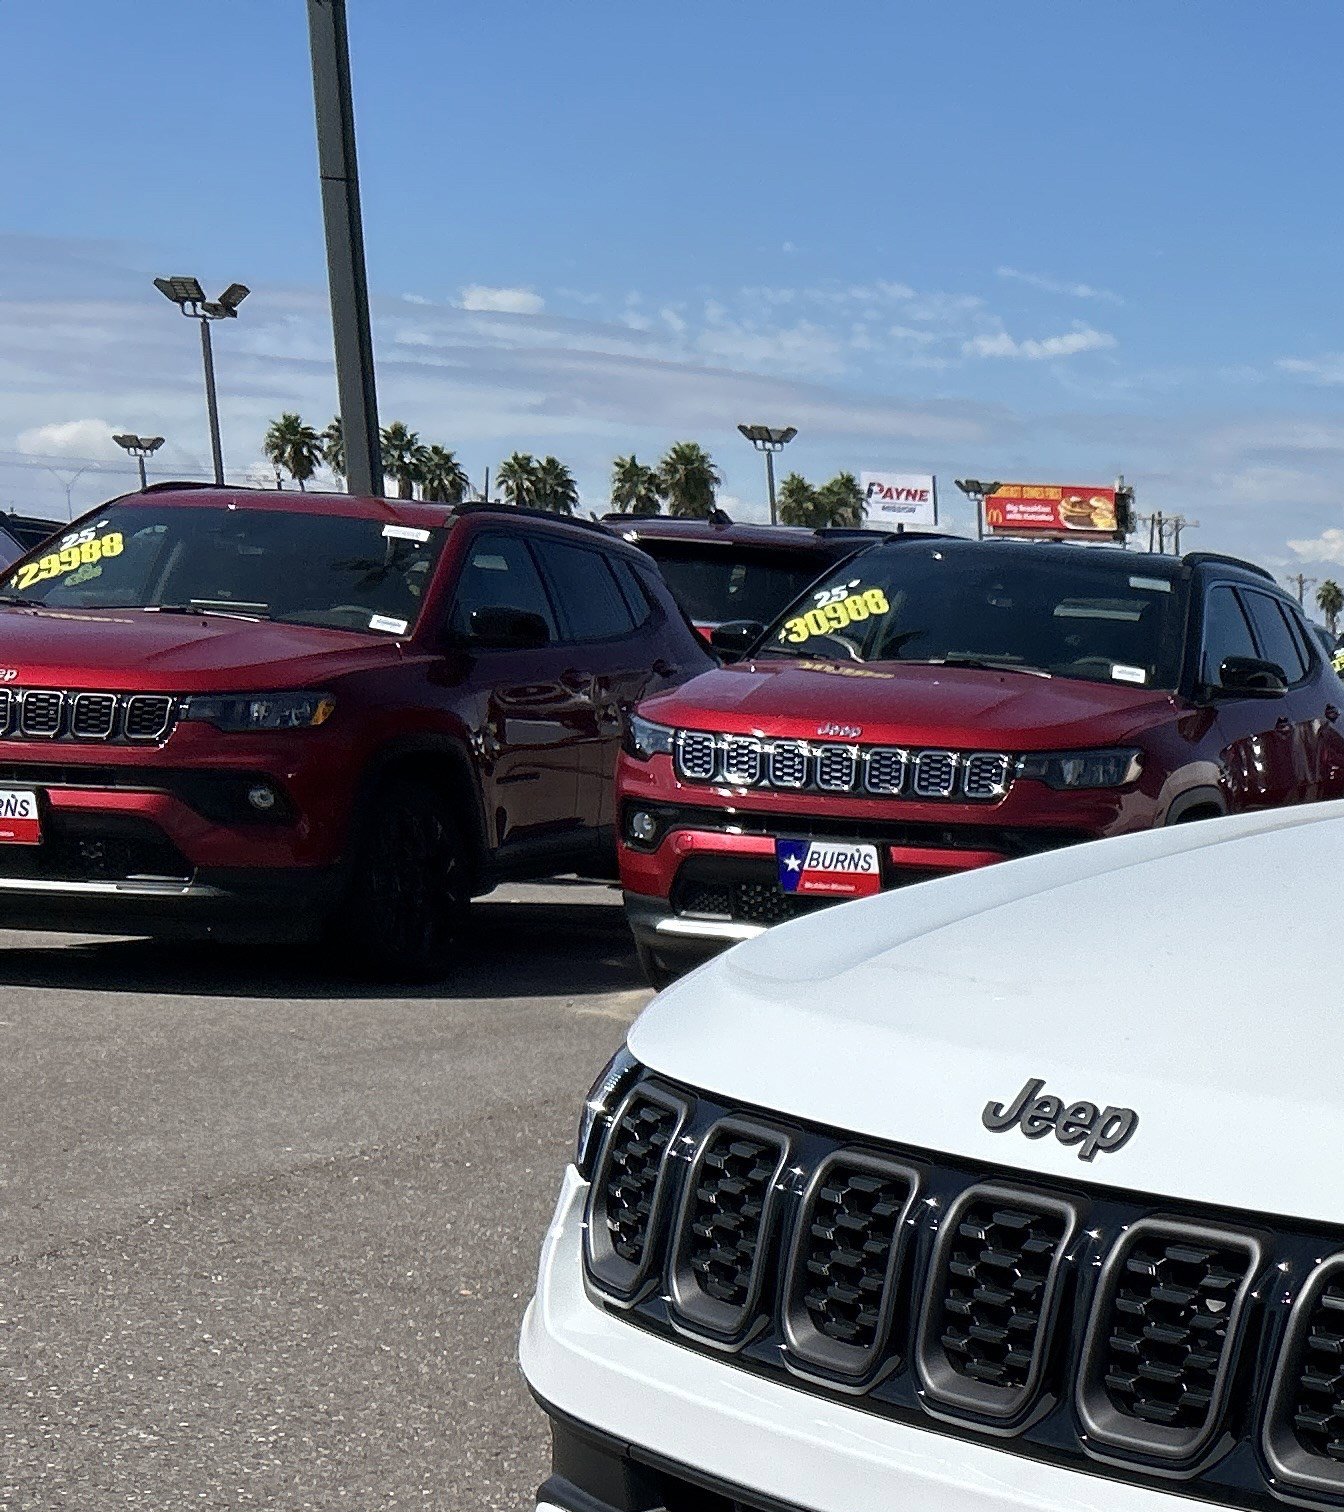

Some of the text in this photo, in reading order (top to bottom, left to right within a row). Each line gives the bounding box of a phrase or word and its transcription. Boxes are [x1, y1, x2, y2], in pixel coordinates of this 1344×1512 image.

[866, 482, 930, 502] PAYNE
[807, 850, 873, 873] BURNS
[981, 1077, 1140, 1163] Jeep
